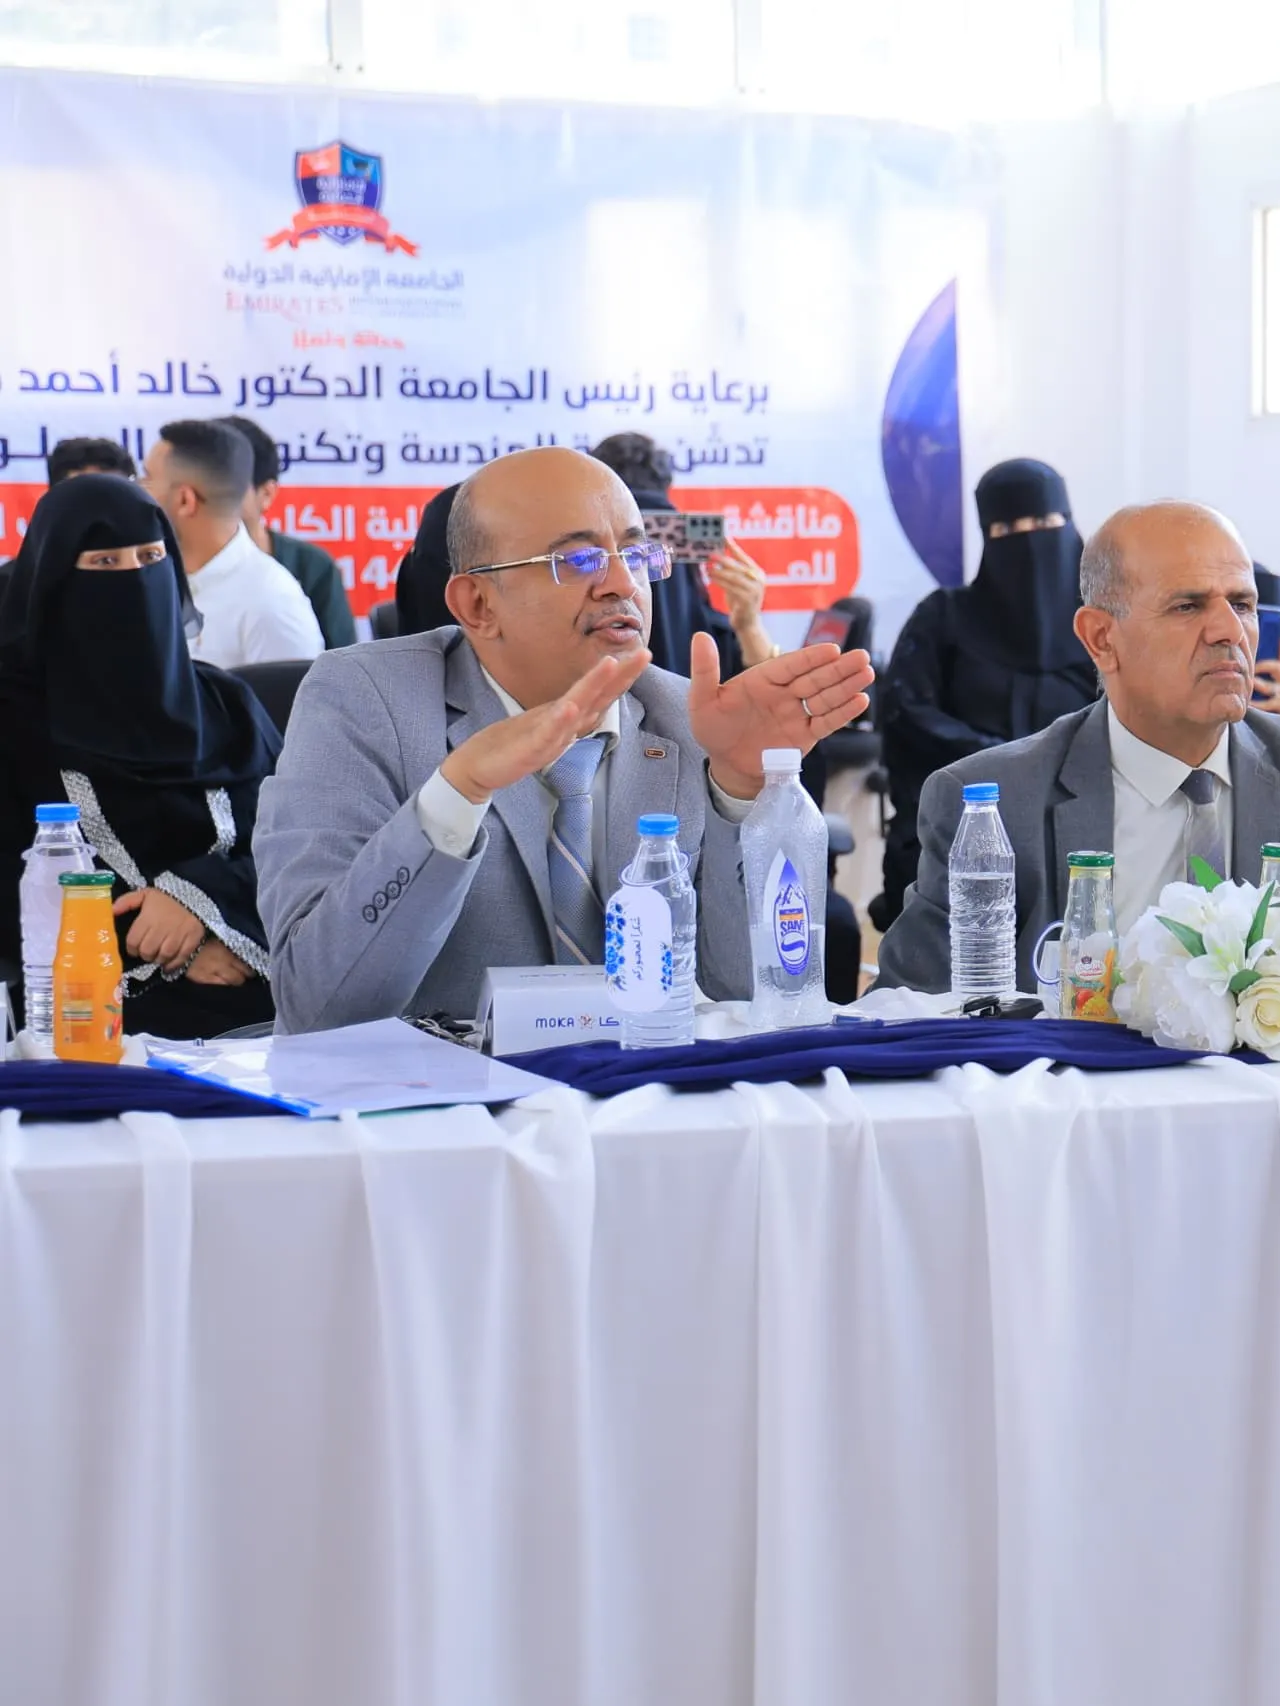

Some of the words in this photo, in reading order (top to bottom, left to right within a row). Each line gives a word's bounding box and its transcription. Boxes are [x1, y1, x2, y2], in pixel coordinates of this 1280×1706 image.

[19, 349, 119, 394] أحمد
[137, 361, 222, 395] خالد
[235, 364, 383, 408] الدكتور
[398, 367, 549, 411] الجامعة
[563, 371, 655, 413] رئيس
[670, 368, 769, 415] برعاية
[365, 503, 423, 550] لبة
[723, 501, 842, 539] مناقشة
[535, 1016, 575, 1029] MOKA
[599, 1015, 621, 1027] كا
